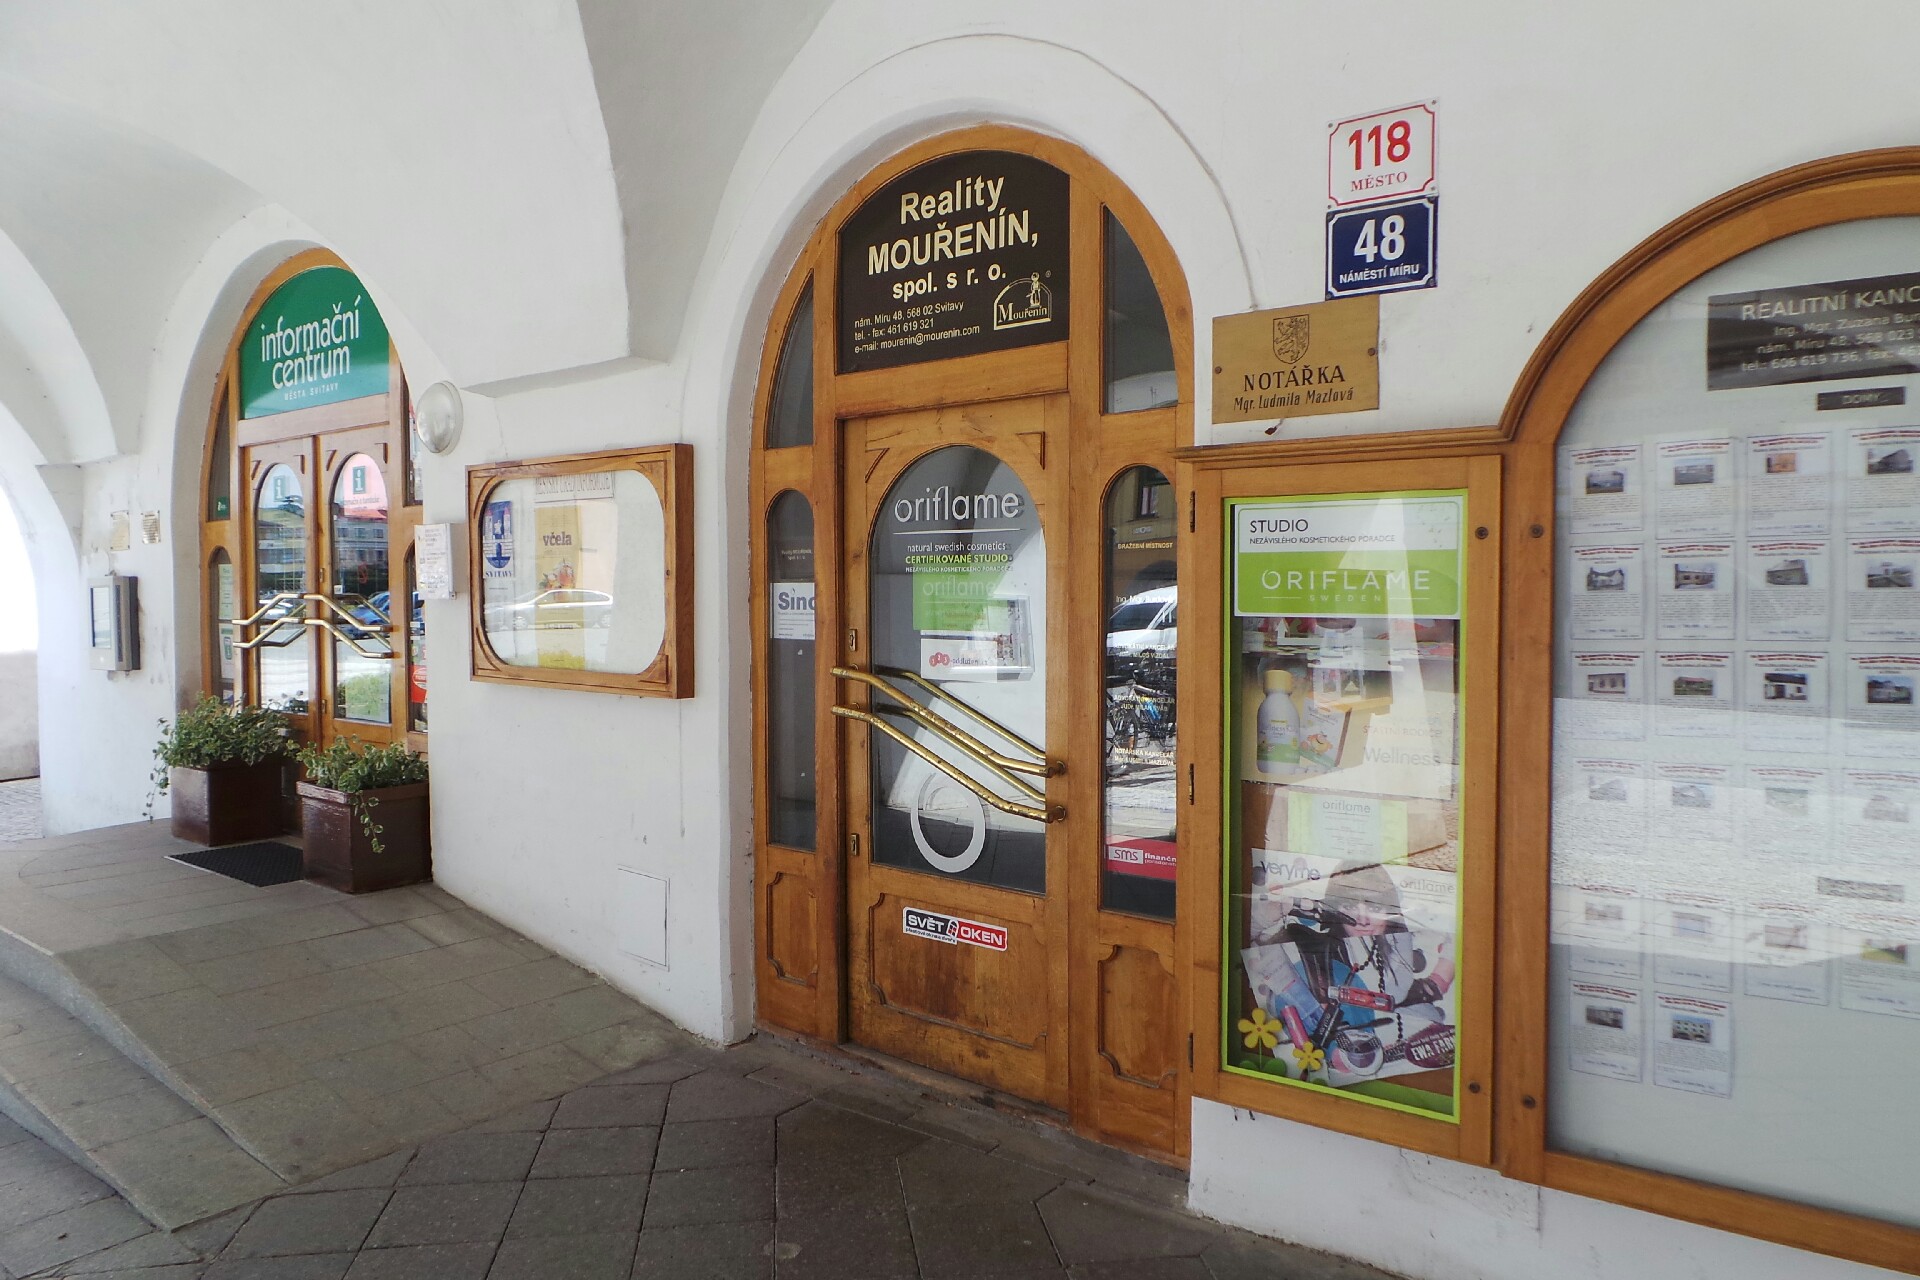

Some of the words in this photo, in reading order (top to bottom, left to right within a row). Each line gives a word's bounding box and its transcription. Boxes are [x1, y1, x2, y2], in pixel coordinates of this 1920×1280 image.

[1348, 119, 1411, 171] 118
[1350, 171, 1408, 192] MĚSTO
[900, 175, 1005, 225] Reality
[868, 207, 1038, 275] MOUŘENÍN,
[1353, 214, 1405, 263] 48
[892, 272, 938, 302] spol.
[946, 272, 958, 290] s
[966, 269, 979, 286] r.
[988, 263, 1006, 281] o.
[1339, 265, 1388, 284] NÁMĚSTÍ
[1390, 263, 1420, 278] MÍRU
[874, 311, 891, 325] Míru
[906, 306, 921, 319] 568
[922, 304, 933, 316] 02
[934, 300, 964, 315] Svitavy
[1742, 290, 1849, 321] REALITNÍ
[261, 294, 362, 362] informační
[880, 325, 980, 350] mourenin@mourenin.com
[887, 322, 901, 335] 461
[903, 320, 918, 333] 619
[919, 317, 934, 331] 321
[272, 345, 350, 390] centrum
[1244, 363, 1346, 393] NOTÁŘKA
[1233, 395, 1256, 413] Mgr.
[1258, 390, 1301, 409] Ludmila
[1305, 386, 1354, 405] Mazlová
[894, 485, 1021, 523] oriflame
[1249, 518, 1309, 534] STUDIO
[542, 531, 573, 547] včela
[907, 542, 933, 553] natural
[934, 541, 965, 552] swedish
[966, 540, 1006, 551] cosmetics
[1249, 536, 1297, 545] NEZÁVISLÉHO
[1299, 535, 1356, 544] KOSMETICKÉHO
[1358, 534, 1396, 543] PORADCE
[905, 553, 972, 564] CERTIFIKOVANÉ
[973, 553, 1009, 563] STUDIO
[485, 570, 512, 578] SVITAVY
[1261, 568, 1430, 591] ORIFLAME
[1309, 594, 1382, 602] SWEDEN
[1363, 746, 1441, 767] Wellness
[1322, 799, 1371, 813] oriflame
[908, 914, 944, 932] SVĚT
[960, 926, 1003, 946] OKEN
